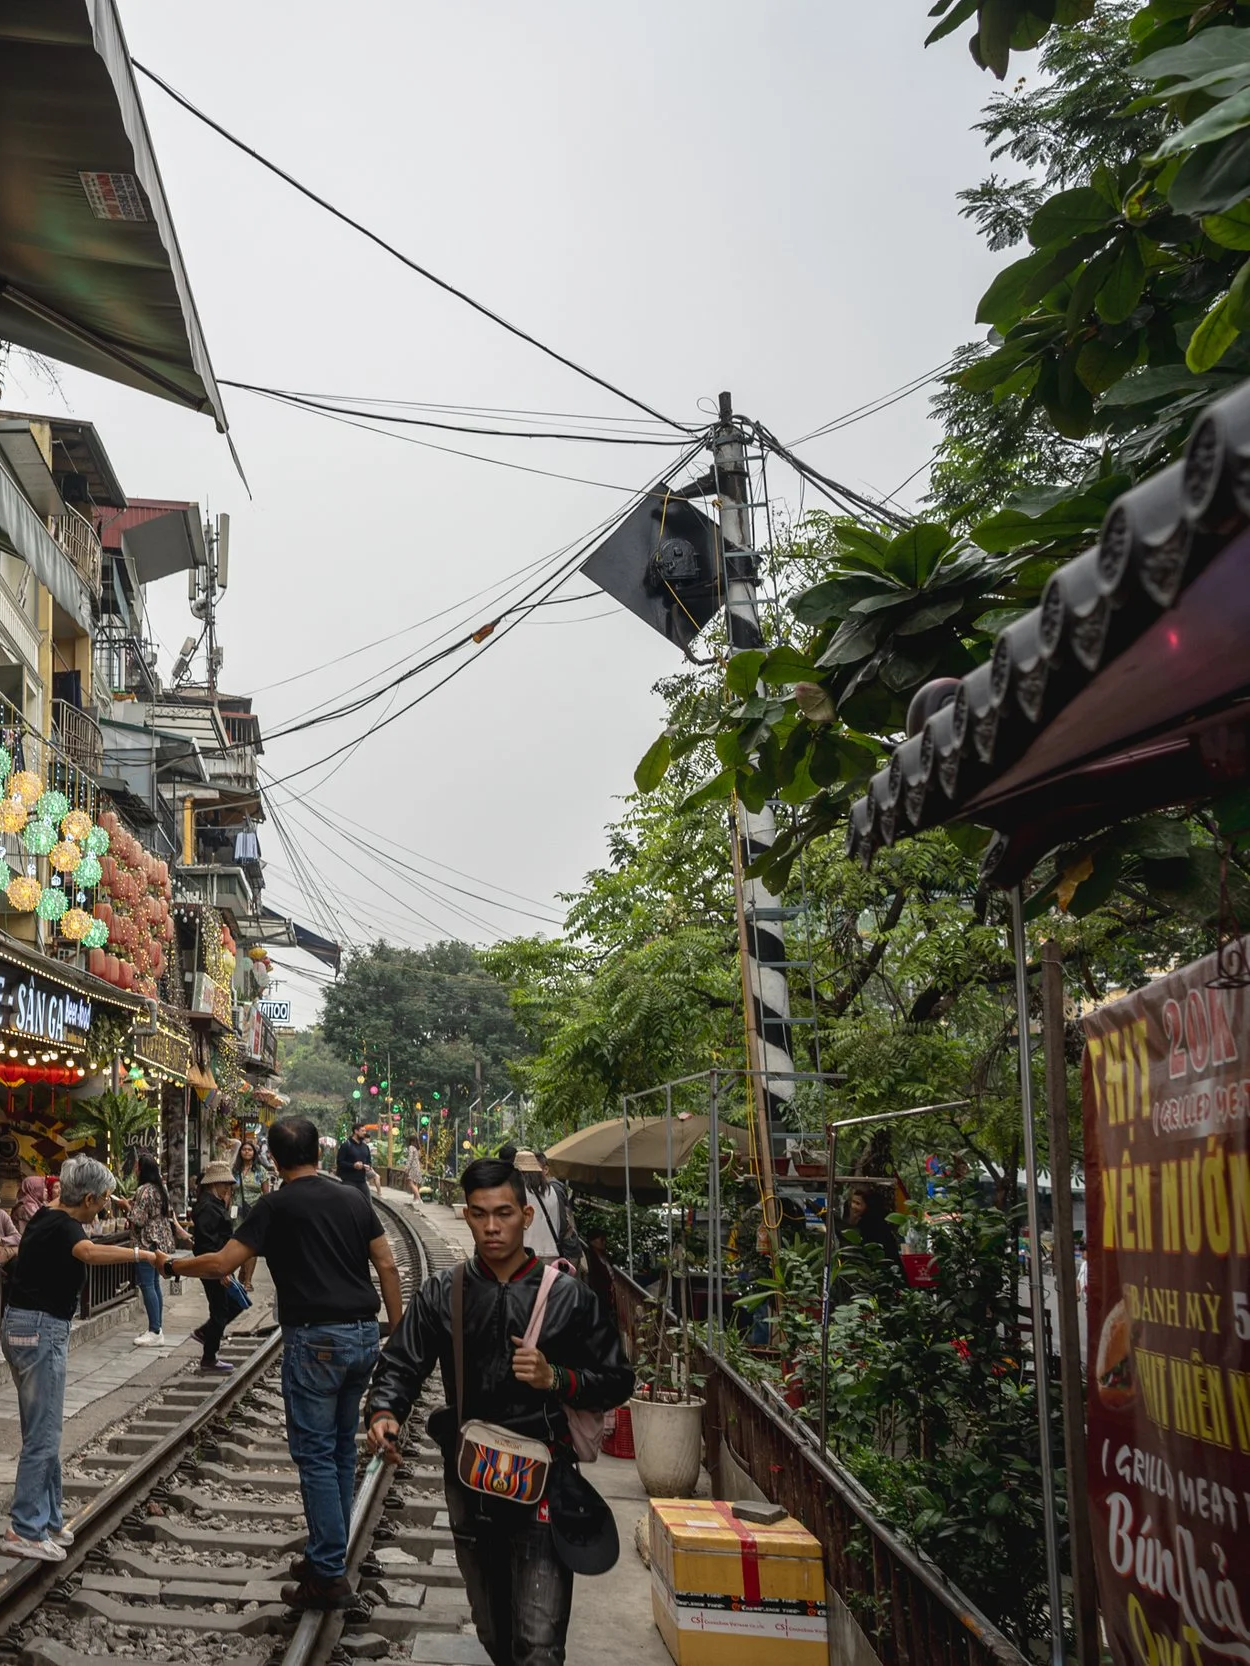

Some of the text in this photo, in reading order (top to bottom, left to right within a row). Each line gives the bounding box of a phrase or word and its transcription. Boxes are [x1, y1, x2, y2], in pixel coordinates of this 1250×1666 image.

[15, 975, 47, 1036] SÂN
[47, 997, 64, 1042] GA
[1129, 1275, 1181, 1329] BÁNH
[1184, 1281, 1222, 1335] MỲ
[1178, 1470, 1238, 1533] MEAT
